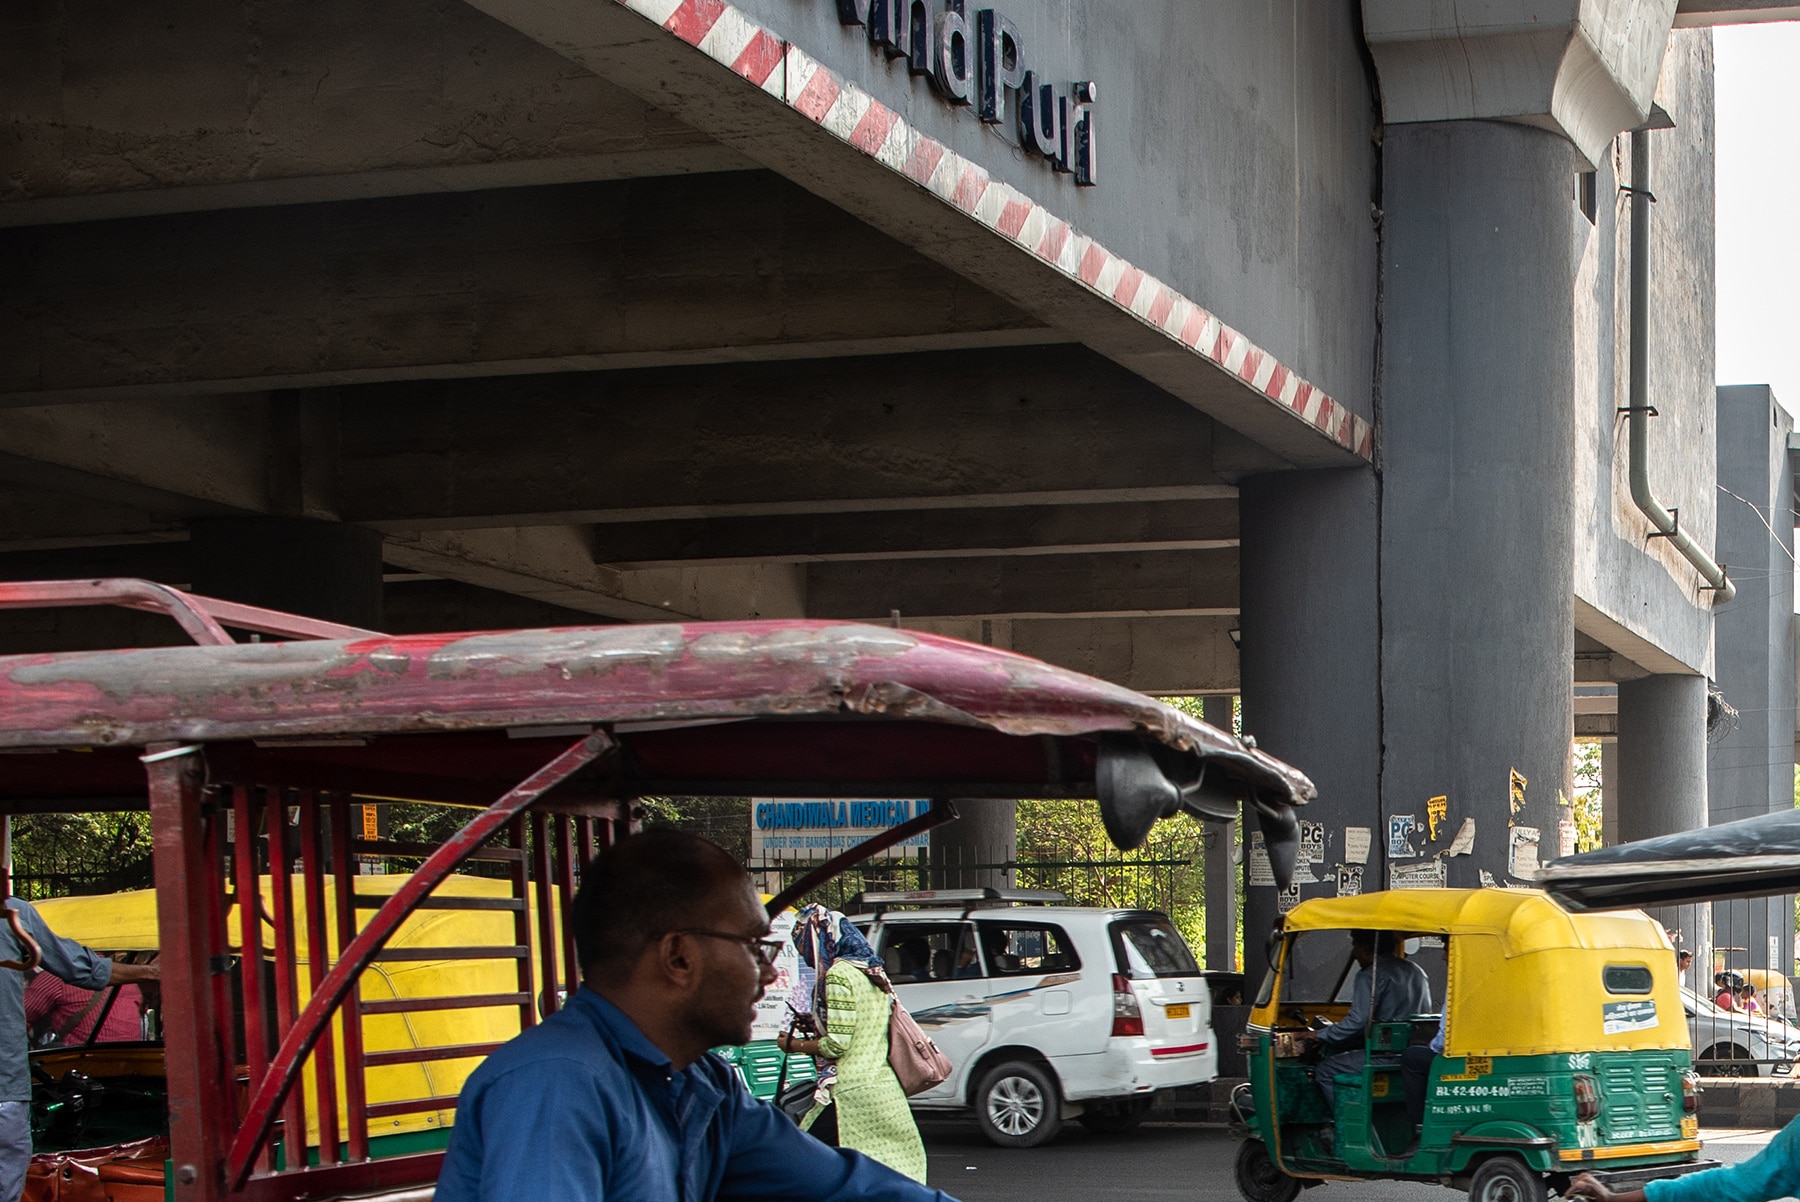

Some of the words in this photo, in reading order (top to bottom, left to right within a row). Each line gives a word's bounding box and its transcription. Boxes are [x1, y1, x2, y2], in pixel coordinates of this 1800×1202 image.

[756, 801, 848, 829] CHANDIWALA
[850, 801, 911, 827] MEDICAL
[1301, 827, 1323, 843] PG
